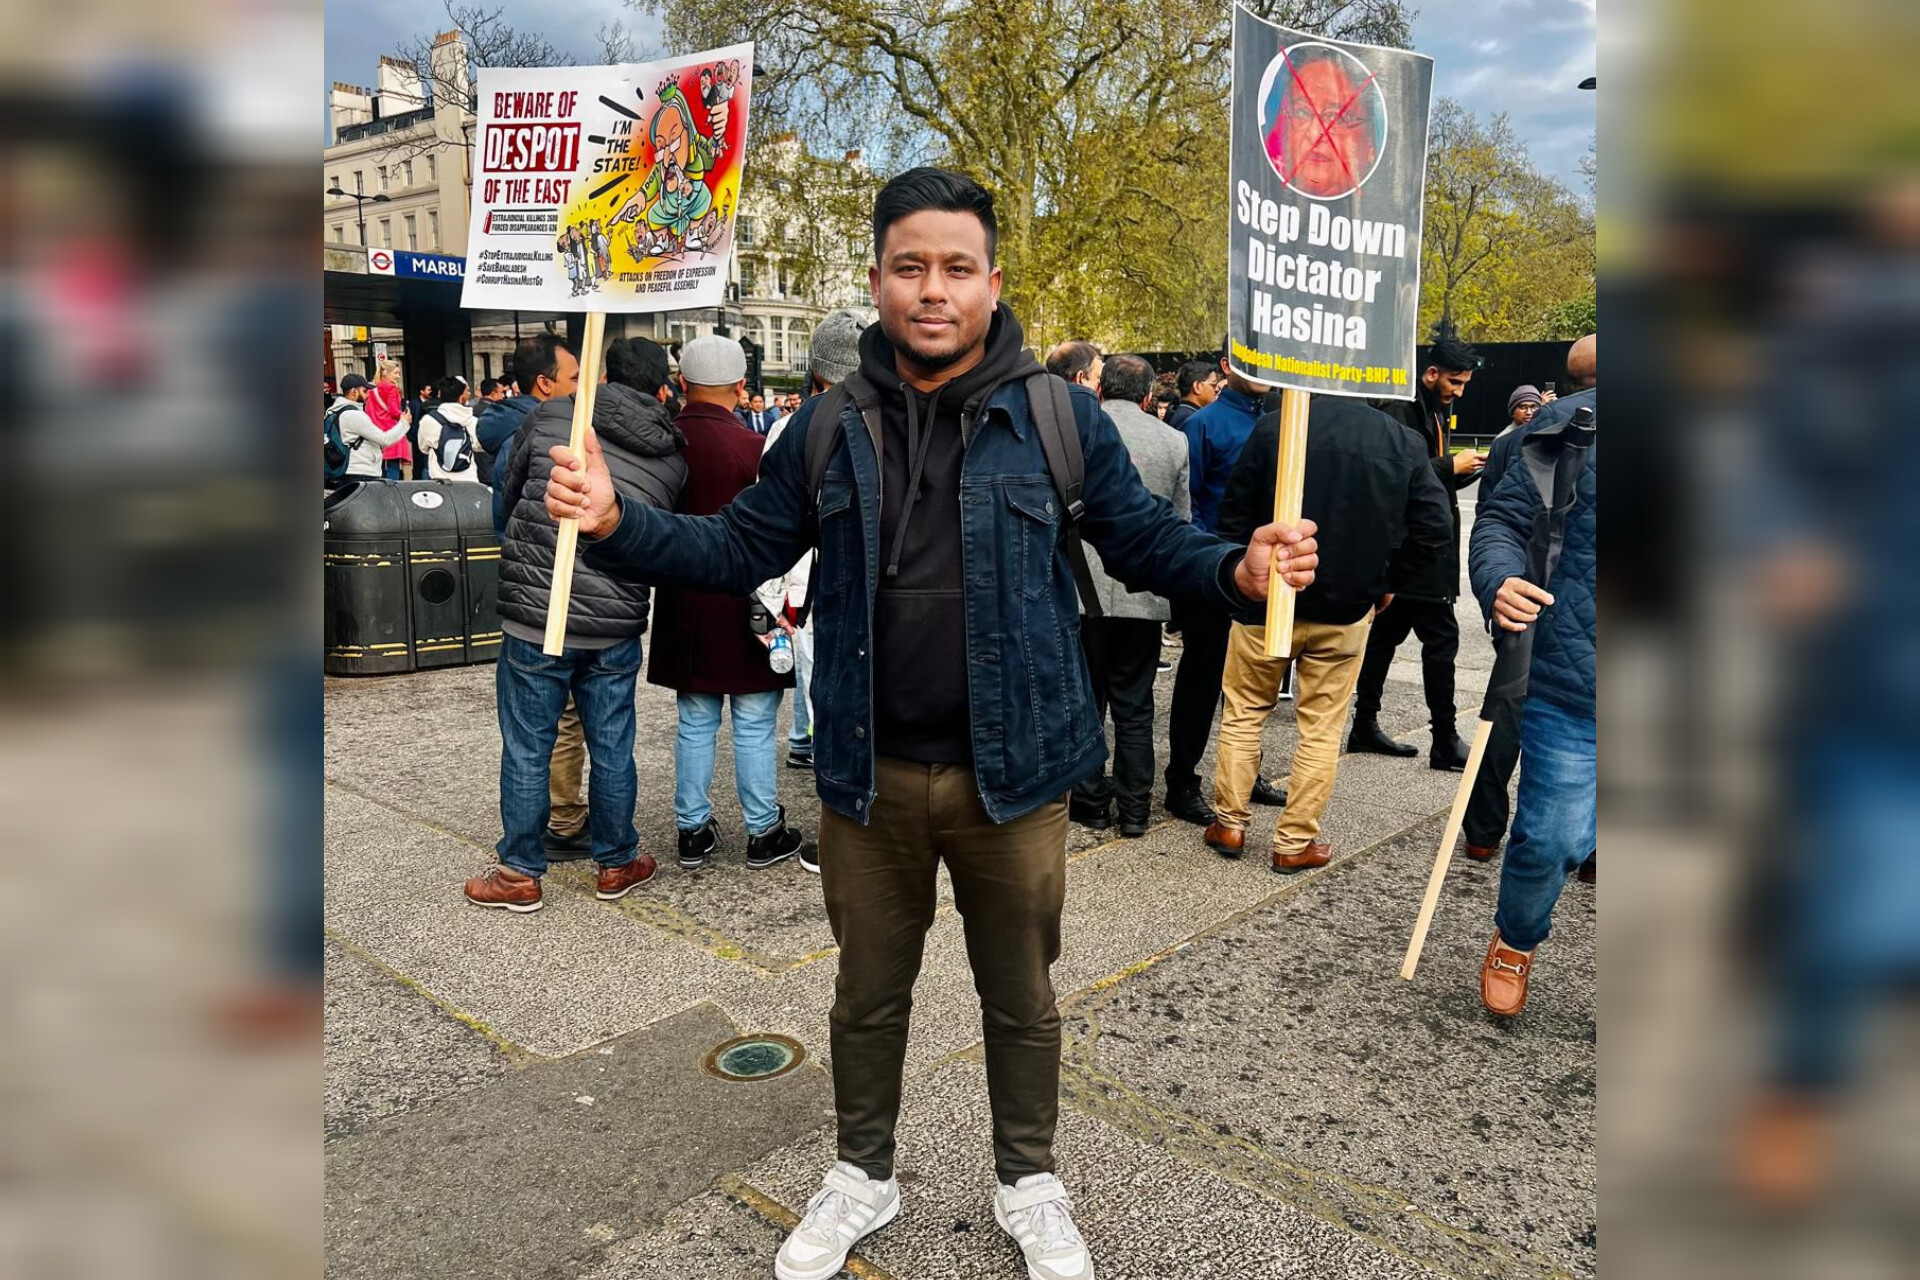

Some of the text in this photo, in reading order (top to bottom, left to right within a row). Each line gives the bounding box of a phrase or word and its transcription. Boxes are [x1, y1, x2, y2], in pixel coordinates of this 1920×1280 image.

[494, 91, 578, 119] BEWARE OF
[612, 120, 632, 135] I'M
[485, 125, 578, 171] DESPOT
[607, 139, 630, 154] THE
[593, 156, 641, 173] STATE!
[484, 178, 572, 204] OF THE EAST
[491, 223, 509, 232] FORCED
[1237, 179, 1406, 258] Step Down
[619, 266, 717, 282] ATTACKS ON FREEDOM OF EXPRESSION
[1248, 236, 1382, 303] Dictator
[635, 280, 700, 293] AND PEACEFUL ASSEMBLY
[1252, 289, 1367, 350] Hasina
[1274, 353, 1331, 379] Nationalist
[1332, 362, 1391, 385] Party-BNP,
[1392, 368, 1408, 386] UK
